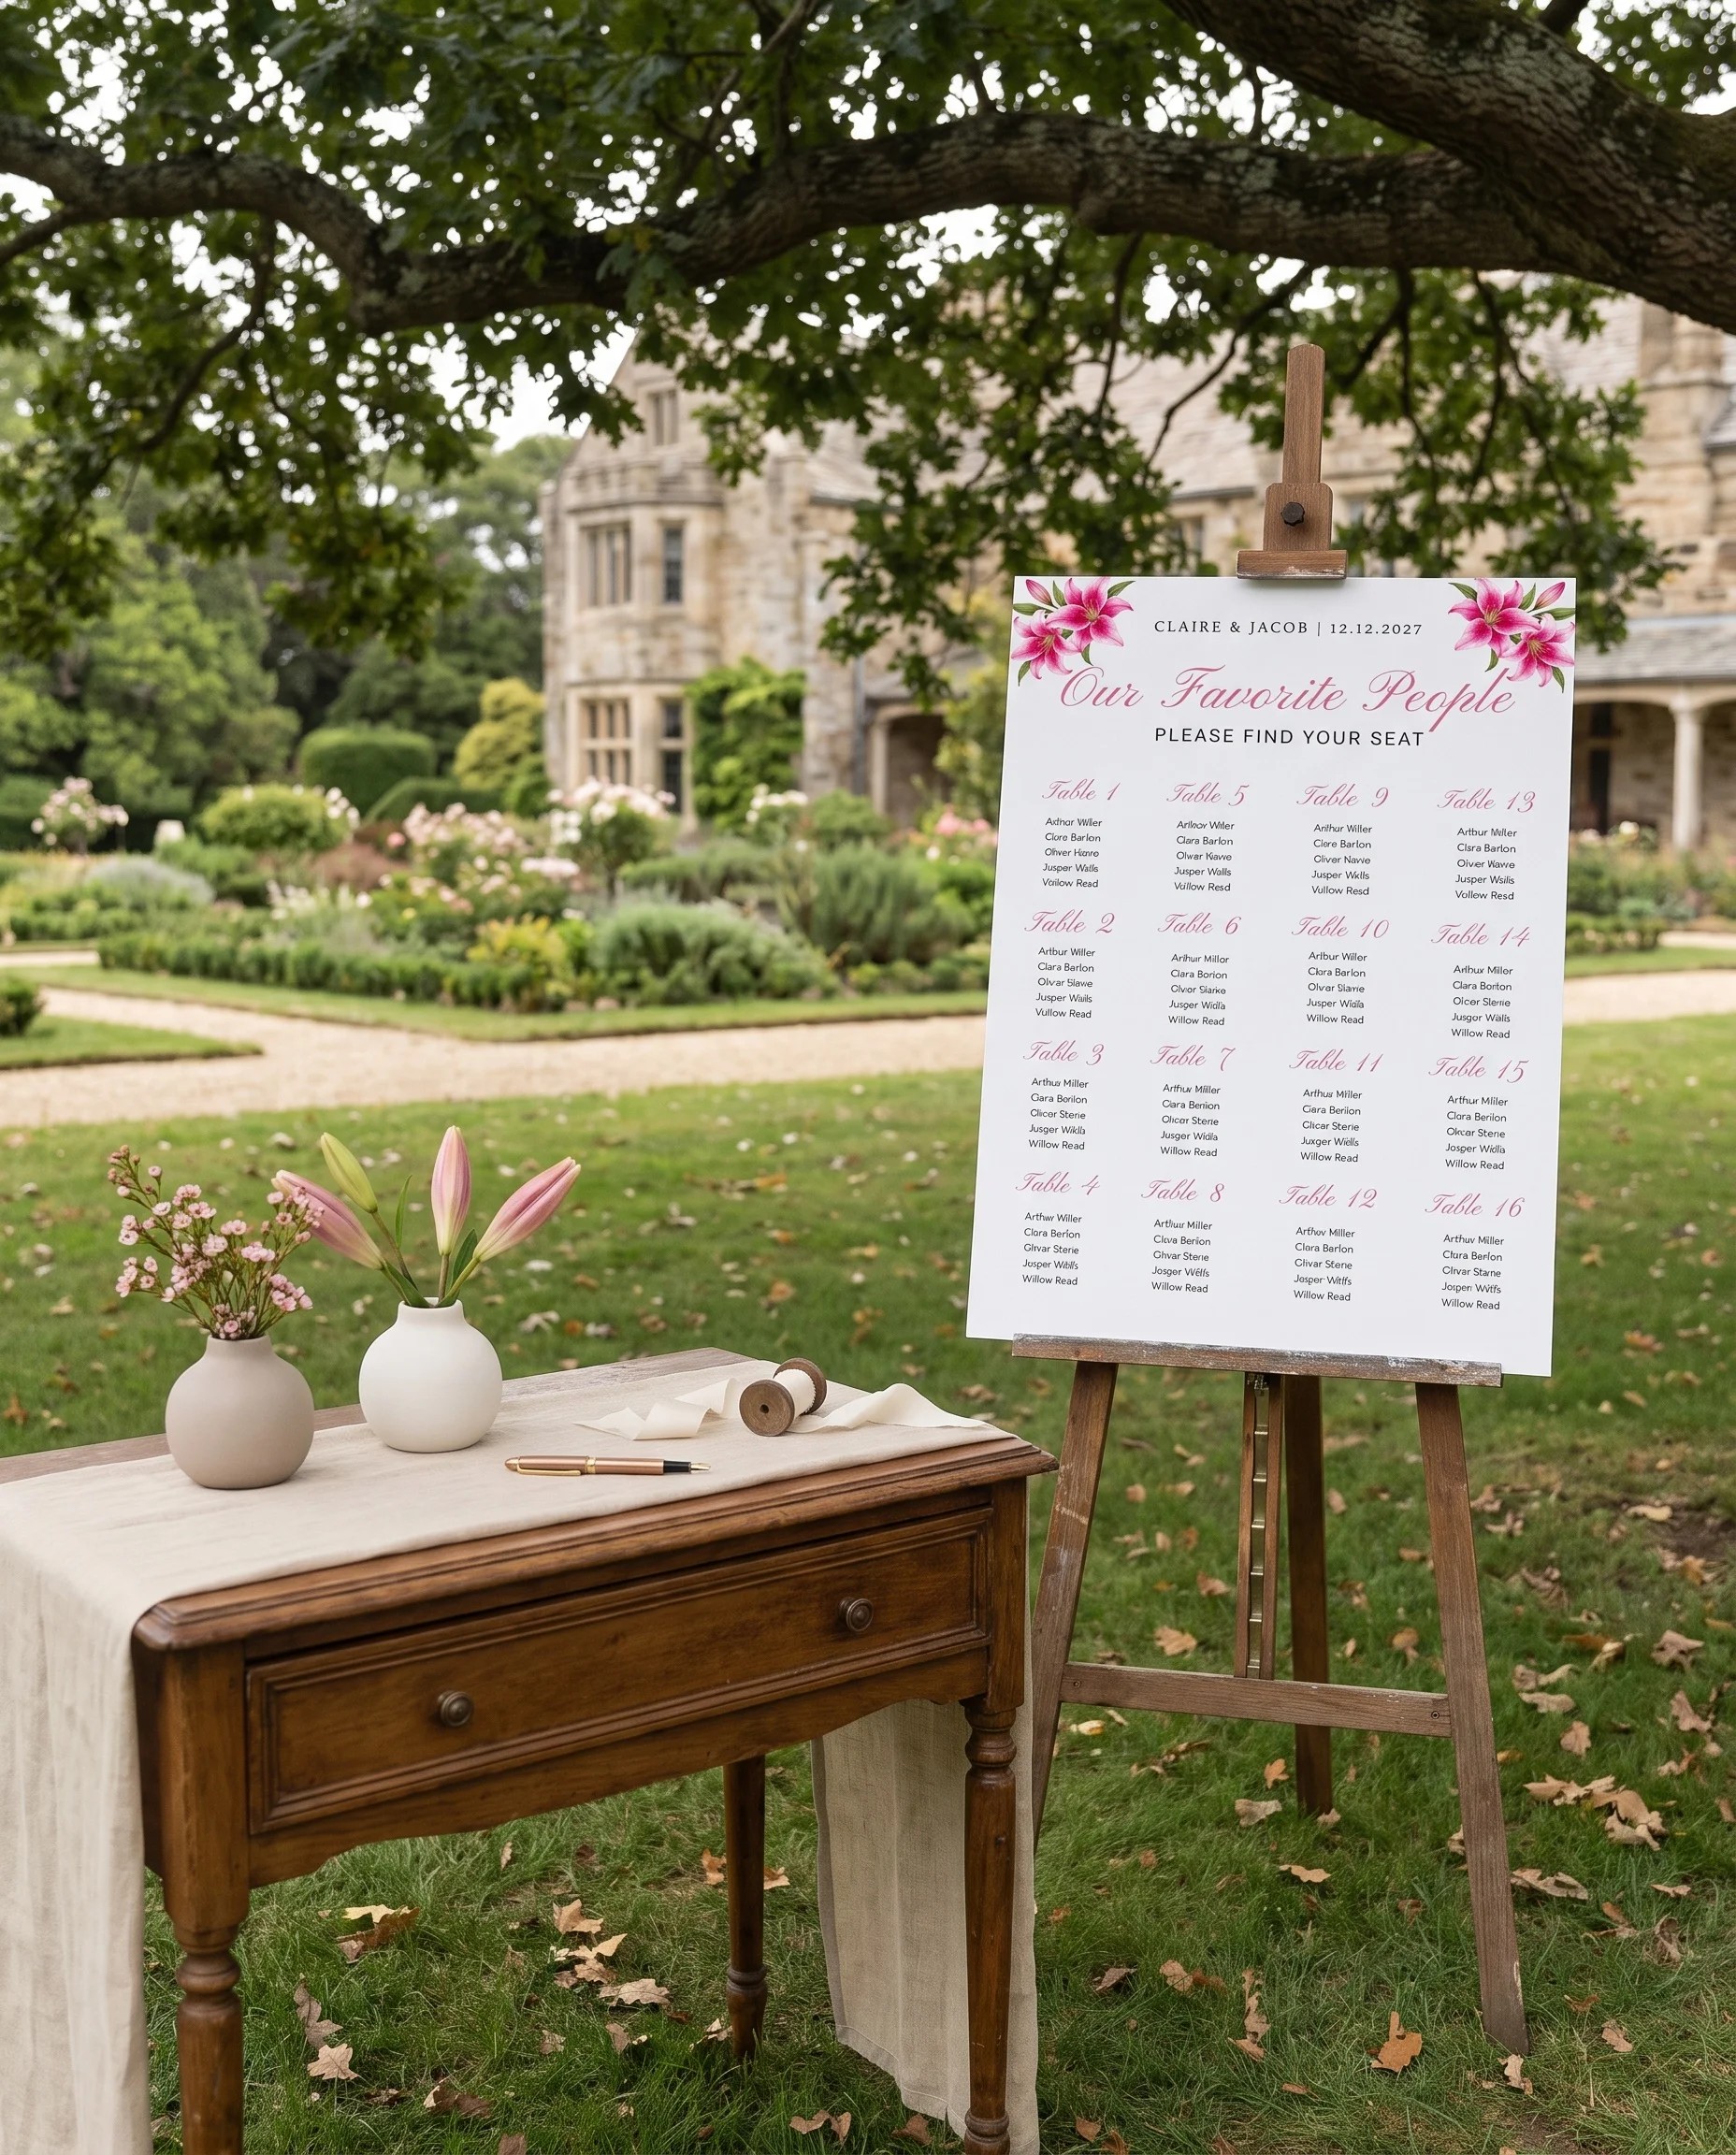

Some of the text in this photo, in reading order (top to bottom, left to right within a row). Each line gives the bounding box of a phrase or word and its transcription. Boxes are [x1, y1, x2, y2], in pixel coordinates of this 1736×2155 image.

[1154, 621, 1221, 632] CLAIRE
[1230, 621, 1240, 632] &
[1249, 622, 1307, 635] JACOB
[1331, 624, 1422, 635] 12.12.2027
[1059, 664, 1516, 733] Our Favorite People
[1156, 728, 1424, 746] PLEASE FIND YOUR SEAT
[1042, 779, 1121, 801] Table 1
[1166, 782, 1250, 806] Table 5
[1296, 784, 1388, 807] Table 9
[1437, 788, 1535, 813] Table 13
[1174, 867, 1205, 877] Jusper
[1311, 870, 1342, 881] Jusper
[1455, 875, 1487, 885] Jusper
[1024, 909, 1115, 933] Table 2
[1158, 912, 1241, 934] Table 6
[1292, 916, 1389, 938] Table 10
[1431, 923, 1529, 947] Table 14
[1035, 992, 1066, 1004] Jusper
[1307, 998, 1337, 1009] Jusper
[1069, 1009, 1092, 1018] Read
[1307, 1014, 1364, 1024] Willow Read
[1168, 1016, 1224, 1025] Willow Read
[1452, 1029, 1510, 1038] Willow Read
[1023, 1040, 1104, 1065] Table 3
[1150, 1045, 1236, 1071] Table 7
[1289, 1049, 1383, 1072] Table 11
[1428, 1056, 1529, 1083] Table 15
[1063, 1079, 1089, 1088] Miller
[1029, 1139, 1085, 1150] Willow Read
[1194, 1148, 1217, 1157] Read
[1300, 1151, 1358, 1163] Willow Read
[1445, 1159, 1504, 1169] Willow Read
[1016, 1171, 1100, 1195] Table 4
[1141, 1179, 1224, 1202] Table 8
[1279, 1184, 1377, 1208] Table 12
[1425, 1193, 1525, 1217] Table 16
[1187, 1221, 1212, 1230] Miller
[1022, 1274, 1078, 1285] Willow Read
[1151, 1281, 1208, 1293] Willow Read
[1294, 1290, 1351, 1301] Willow Read
[1441, 1298, 1499, 1309] Willow Read
